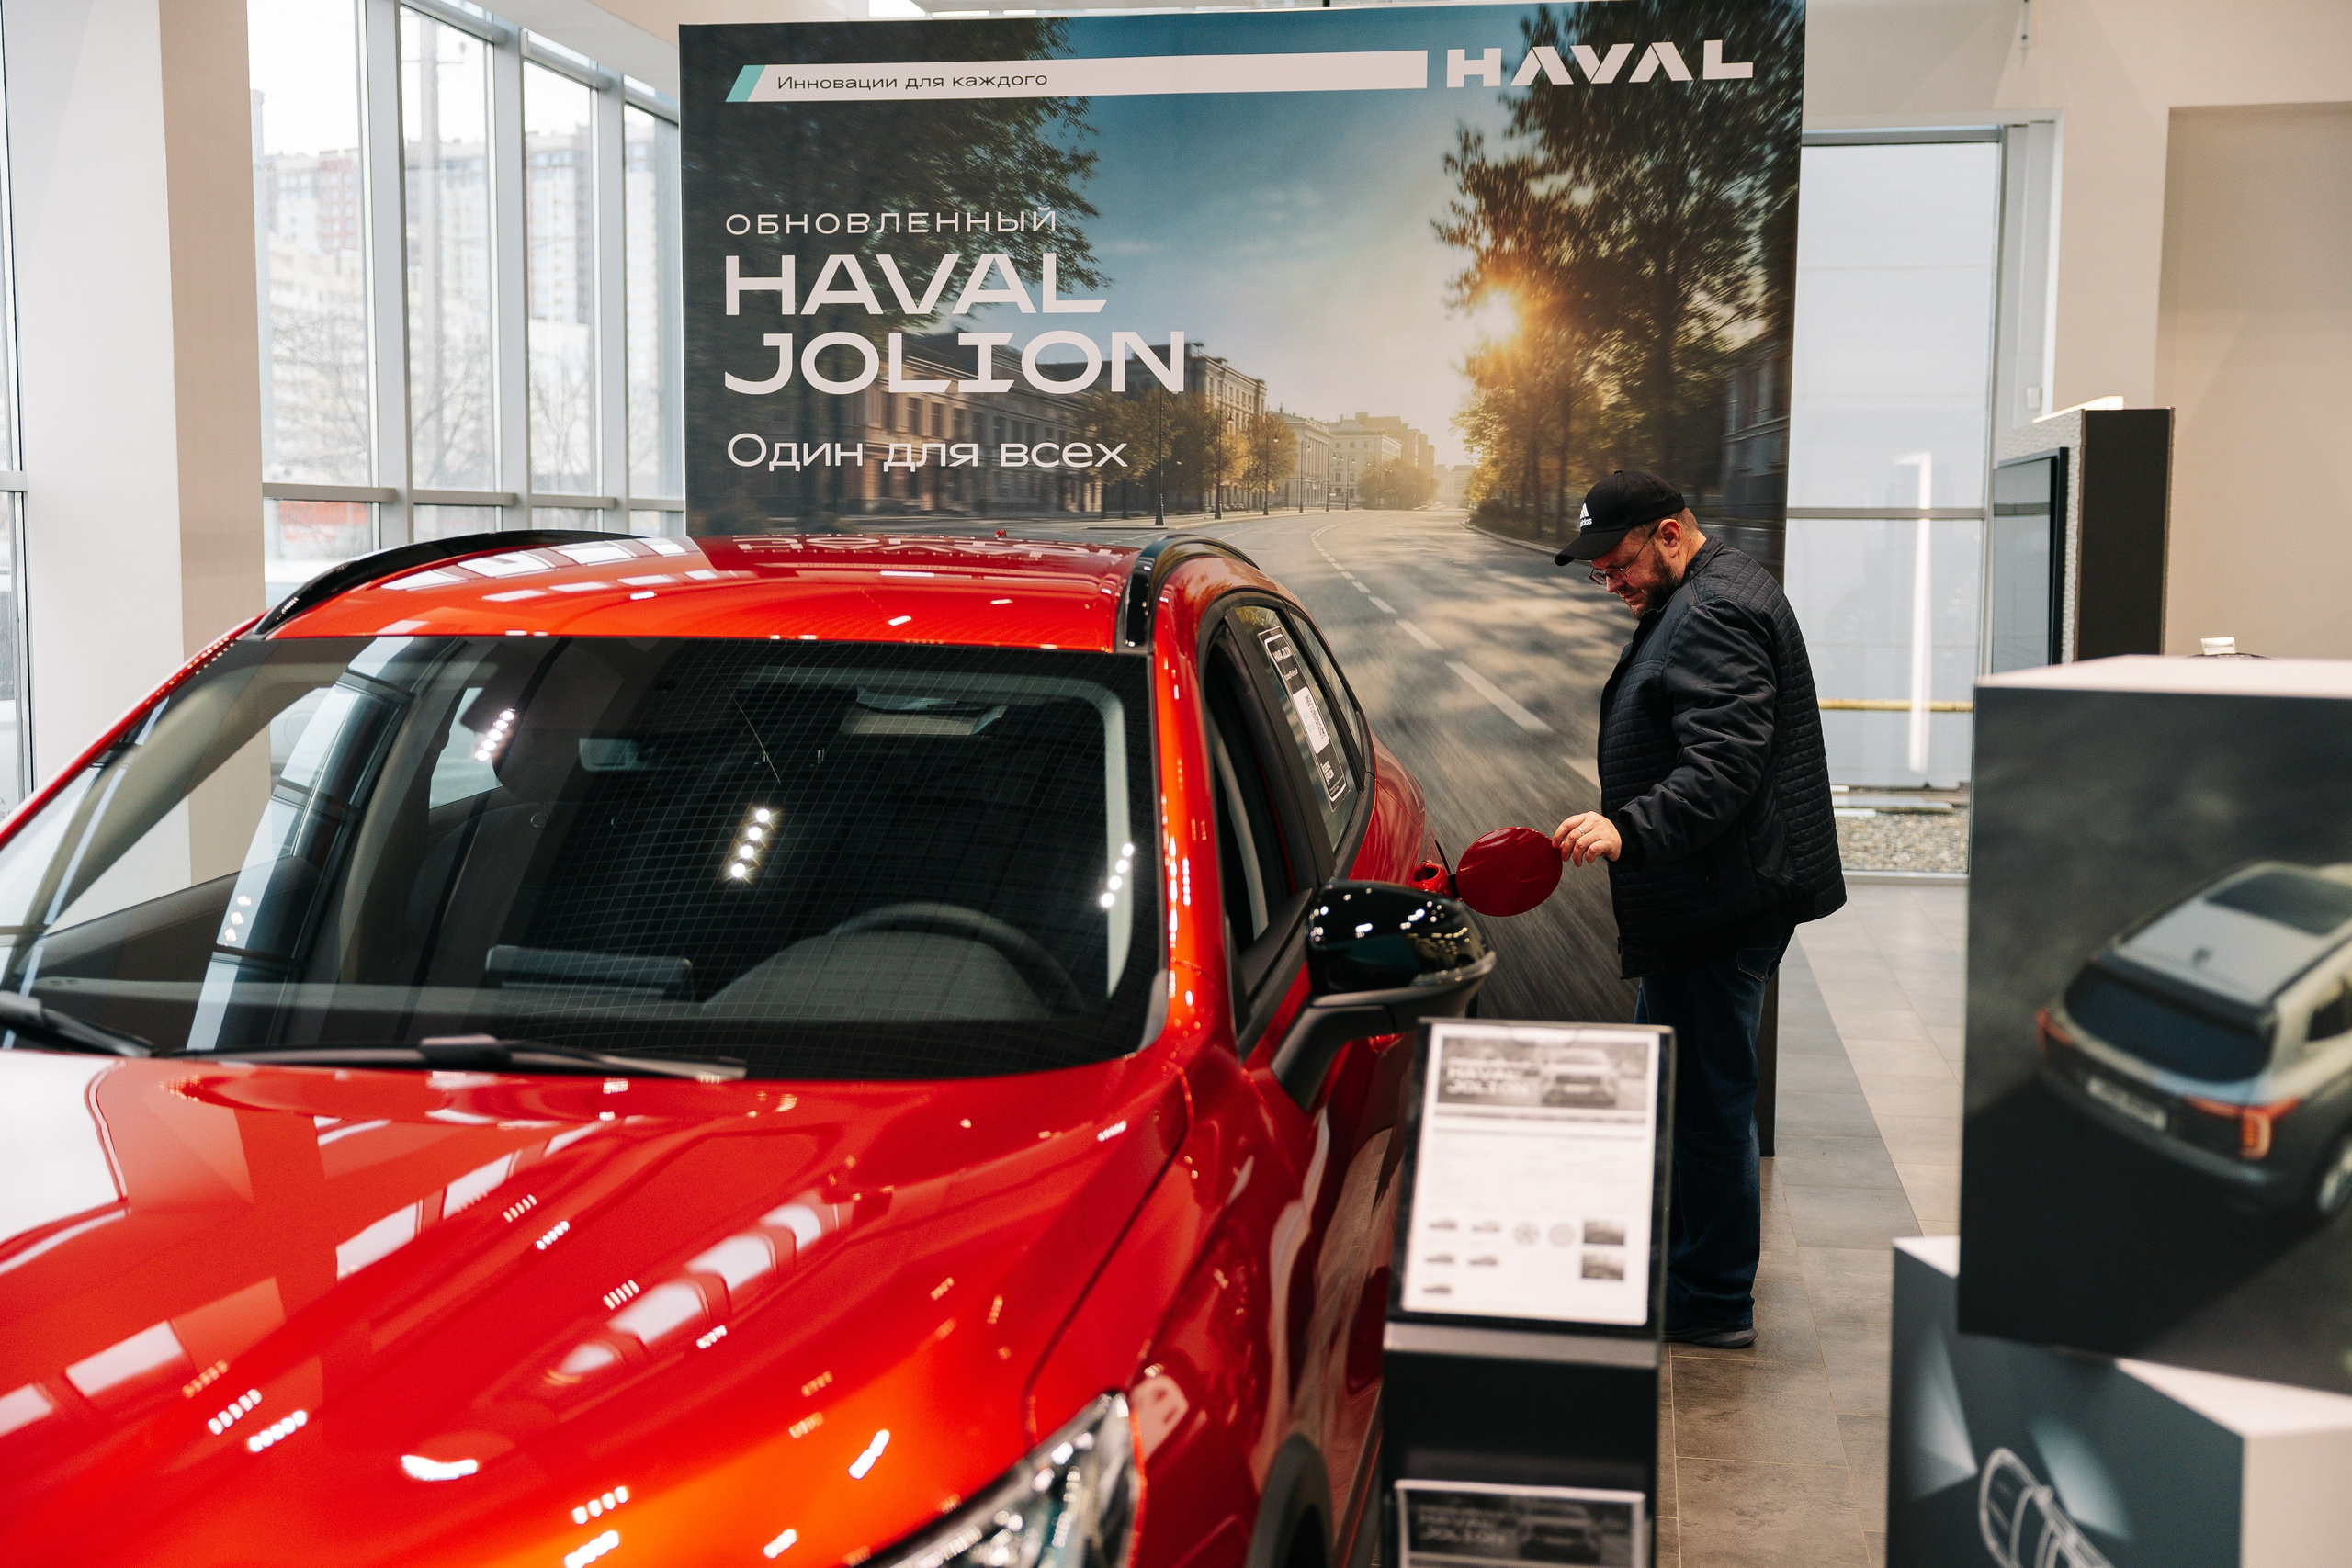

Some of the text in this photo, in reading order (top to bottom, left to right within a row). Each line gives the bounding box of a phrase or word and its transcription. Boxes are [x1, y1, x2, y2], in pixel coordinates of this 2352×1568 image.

[778, 74, 1047, 90] Инновации для каждого
[1447, 40, 1753, 88] HAVAL
[726, 207, 1057, 235] ОБНОВЛЕННЫЙ
[725, 253, 1107, 315] HAVAL
[725, 331, 1185, 395] JOLION
[727, 434, 1128, 472] Один для всех
